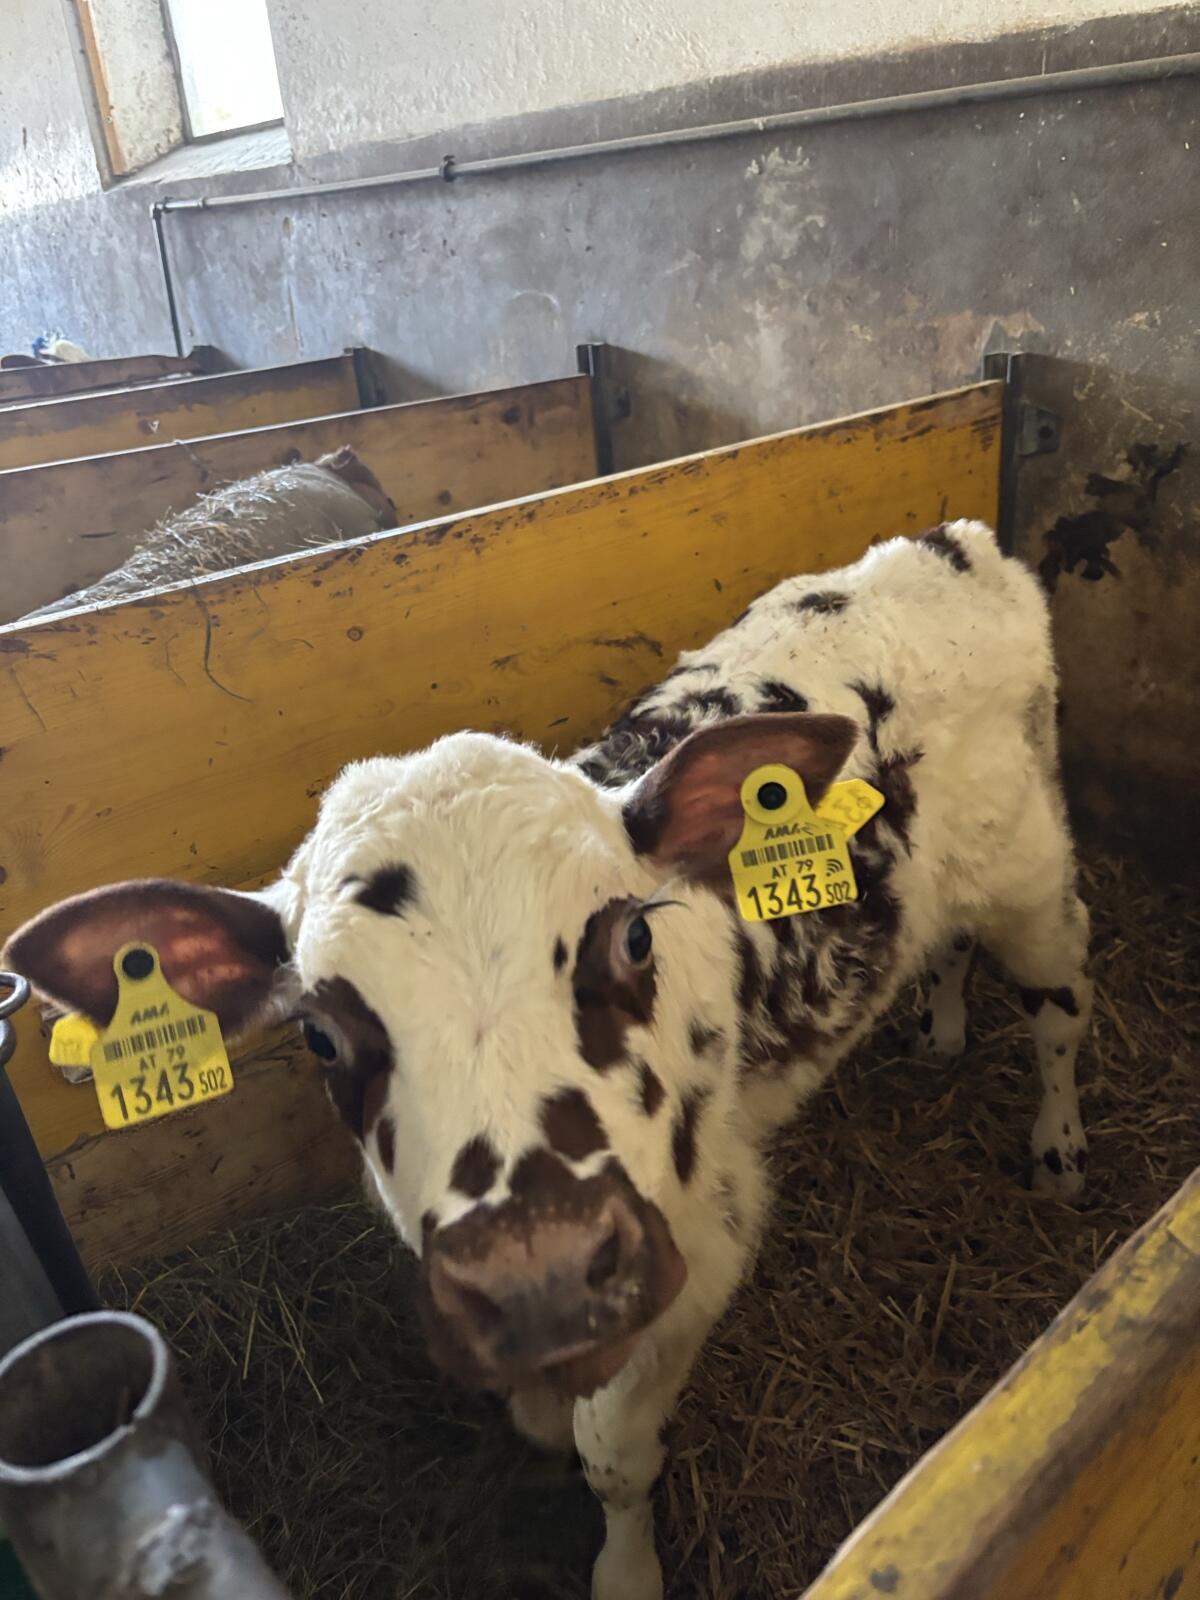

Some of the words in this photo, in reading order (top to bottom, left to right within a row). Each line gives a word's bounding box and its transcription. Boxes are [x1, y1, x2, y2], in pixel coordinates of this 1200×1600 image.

[772, 864, 788, 880] AT
[796, 859, 814, 874] 79
[747, 874, 821, 919] 1343
[825, 881, 853, 904] 502
[139, 1055, 157, 1072] AT
[167, 1046, 185, 1065] 79
[111, 1063, 194, 1120] 1343
[199, 1066, 227, 1094] 502
